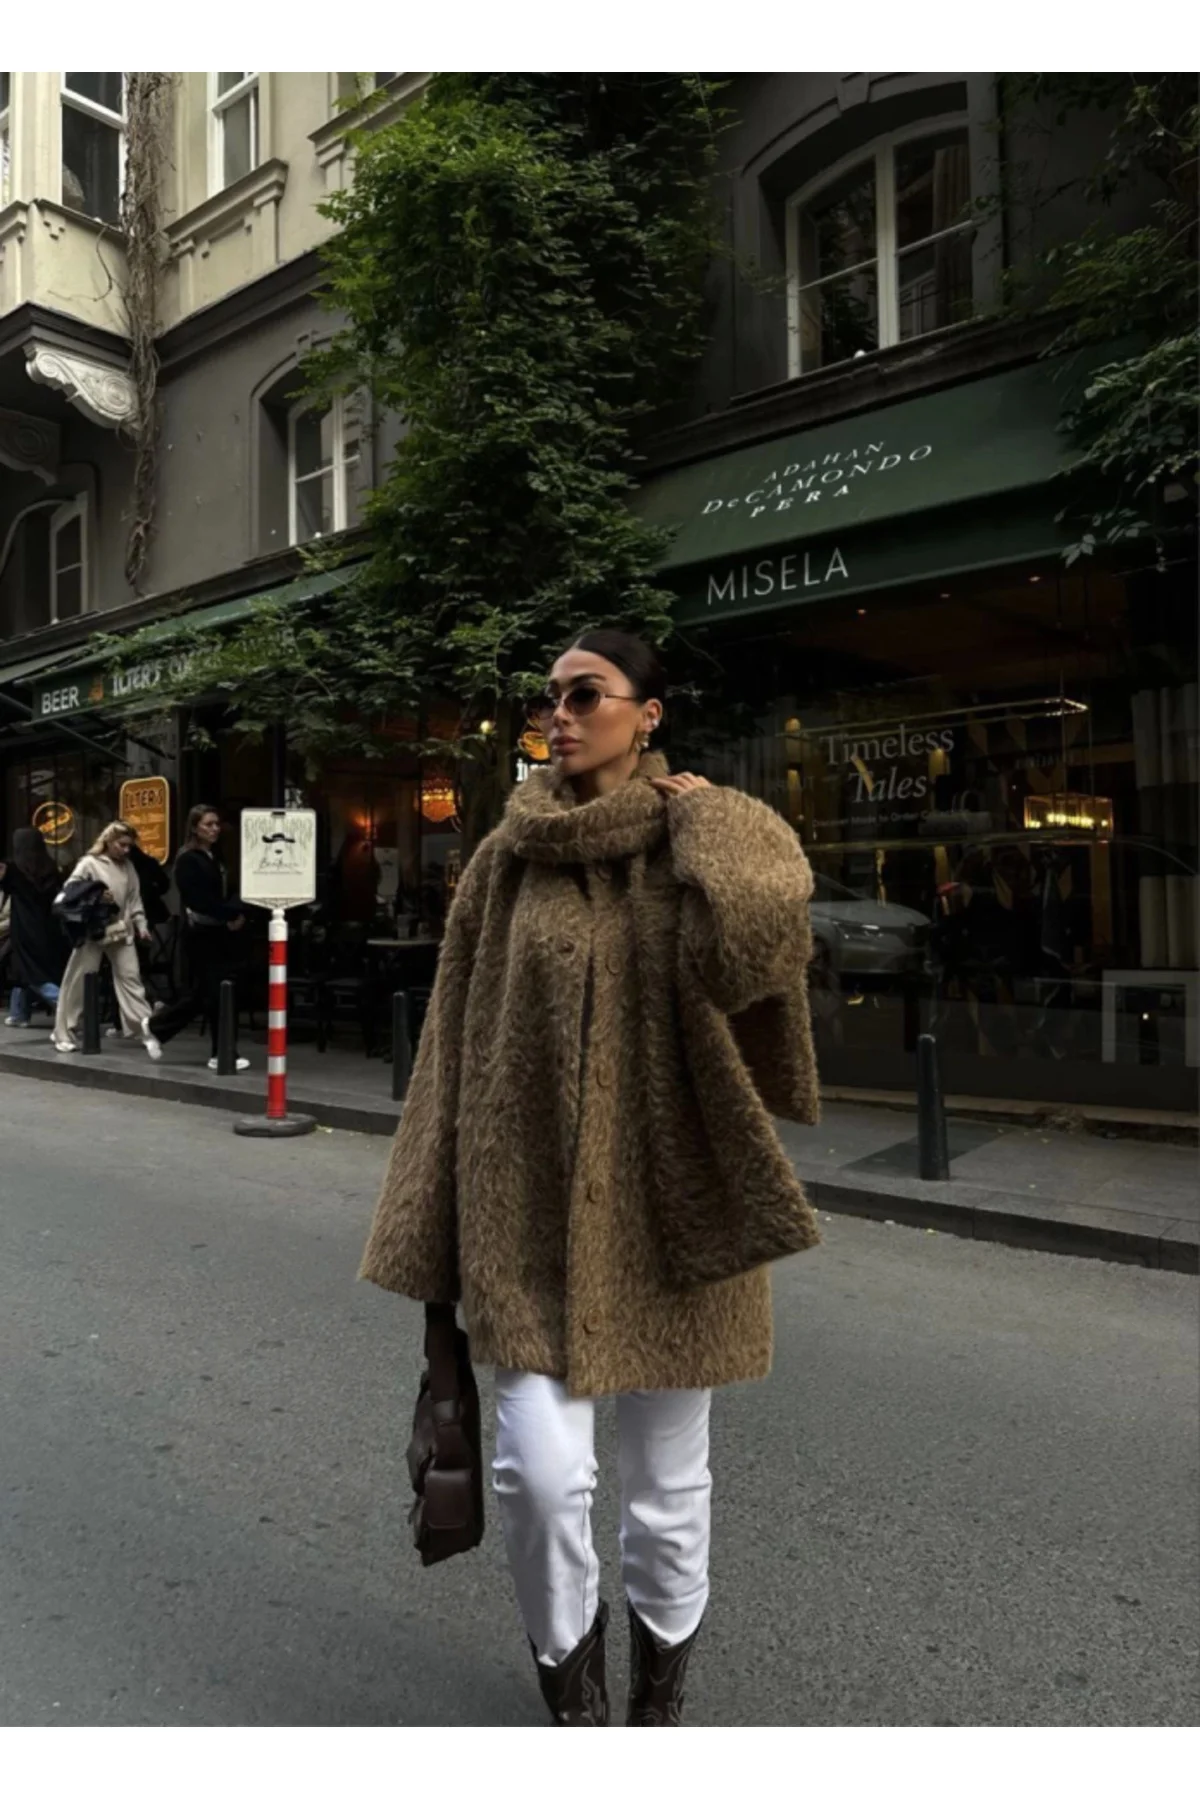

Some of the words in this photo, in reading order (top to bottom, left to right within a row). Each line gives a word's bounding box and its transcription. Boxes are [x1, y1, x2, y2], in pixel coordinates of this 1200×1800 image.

[764, 441, 886, 483] ADAHAN
[749, 484, 851, 518] PERA
[707, 547, 850, 606] MISELA
[40, 685, 80, 714] BEER
[819, 723, 955, 766] Timeless
[848, 765, 928, 803] Tales
